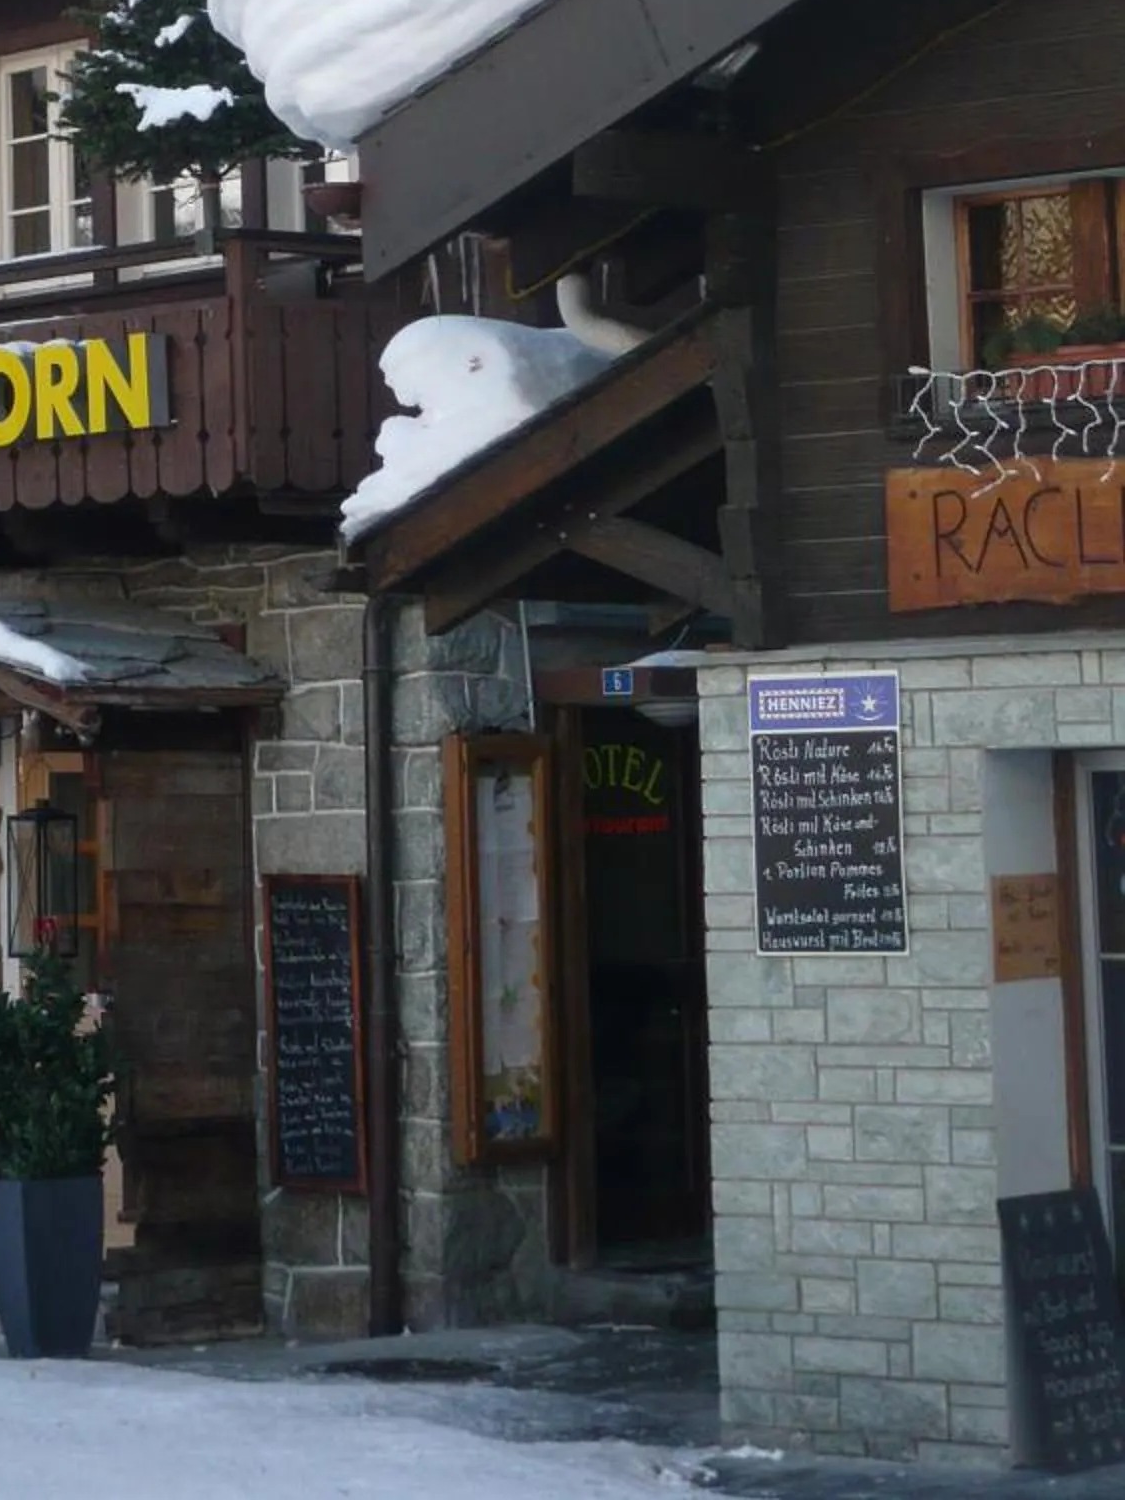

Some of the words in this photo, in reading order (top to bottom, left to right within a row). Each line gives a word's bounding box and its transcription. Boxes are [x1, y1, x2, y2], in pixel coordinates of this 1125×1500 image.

[932, 485, 1125, 578] RACL
[766, 695, 837, 712] HENNIEZ
[804, 736, 851, 760] Nature
[818, 787, 873, 809] Schinken
[794, 836, 853, 857] Schinken
[830, 861, 884, 879] Pommes
